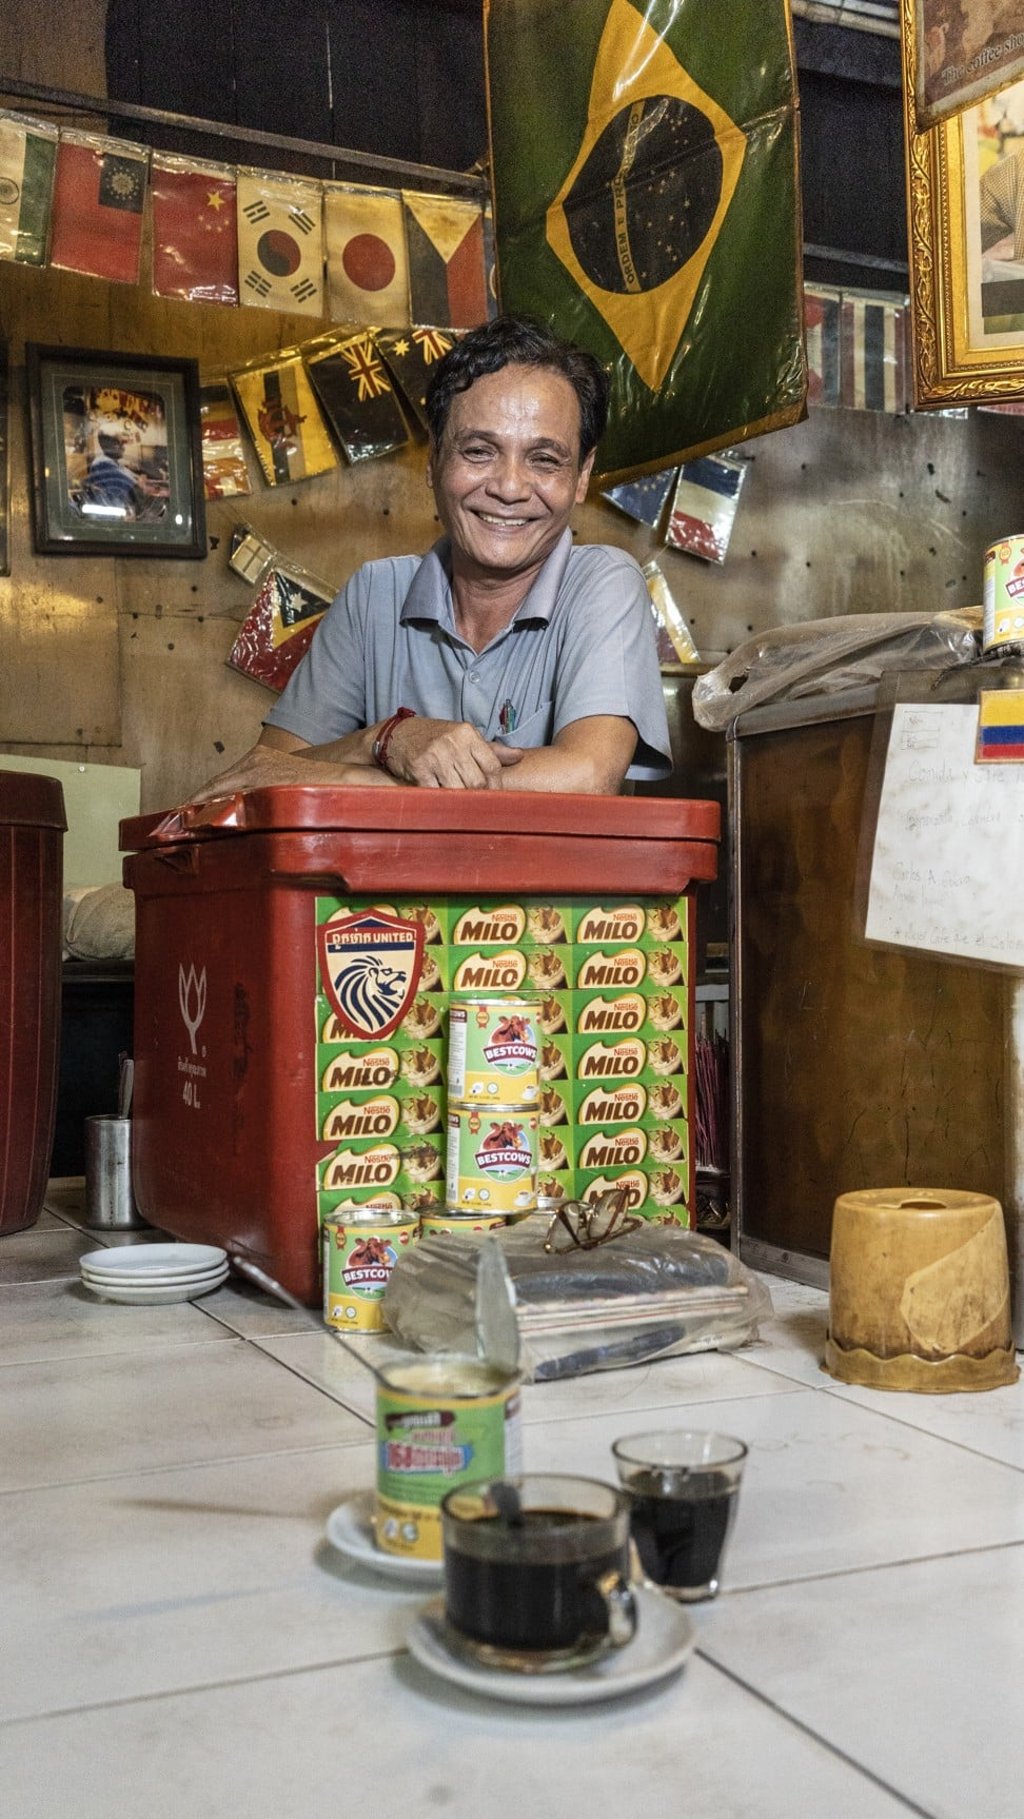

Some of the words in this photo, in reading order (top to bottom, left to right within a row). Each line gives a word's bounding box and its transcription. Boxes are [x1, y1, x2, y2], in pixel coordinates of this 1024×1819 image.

[965, 46, 1002, 74] coffee
[618, 233, 635, 284] ORDEM
[373, 932, 413, 944] UNITED
[460, 921, 518, 941] MILO
[583, 921, 638, 940] MILO
[460, 968, 518, 988] MILO
[584, 966, 639, 985] MILO
[584, 1010, 639, 1030] MILO
[486, 1046, 536, 1059] BESTCOWS
[584, 1056, 639, 1076] MILO
[329, 1066, 391, 1088] MILO
[585, 1101, 639, 1121] MILO
[330, 1115, 391, 1137] MILO
[477, 1152, 531, 1166] BESTCOWS
[586, 1146, 640, 1167] MILO
[332, 1164, 392, 1186] MILO
[588, 1188, 641, 1208] MO
[343, 1268, 390, 1283] BESTCO
